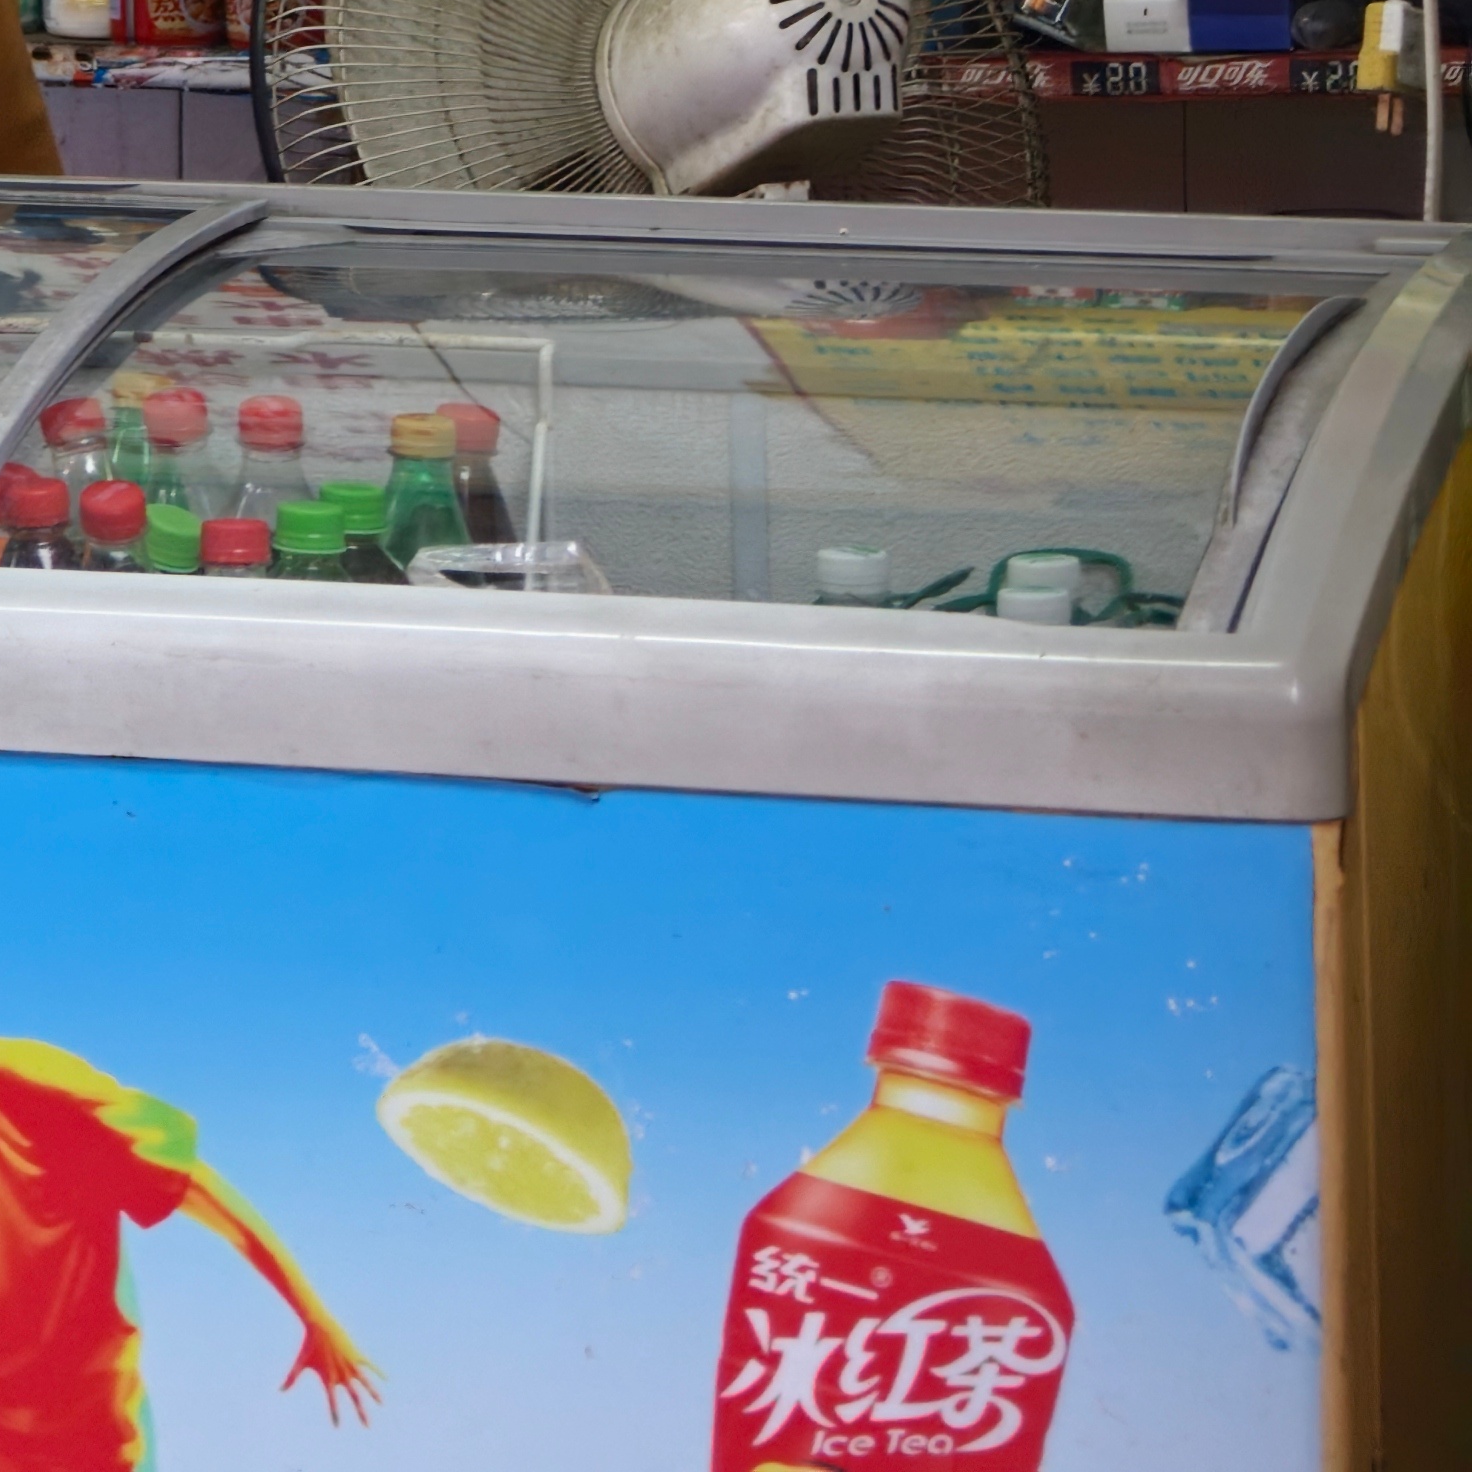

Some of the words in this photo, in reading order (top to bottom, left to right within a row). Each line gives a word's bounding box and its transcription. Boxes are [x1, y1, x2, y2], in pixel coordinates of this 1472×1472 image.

[746, 1245, 881, 1303] 统一
[721, 1286, 1068, 1455] 冰红茶
[810, 1429, 876, 1456] Ice
[885, 1429, 954, 1457] Tea
